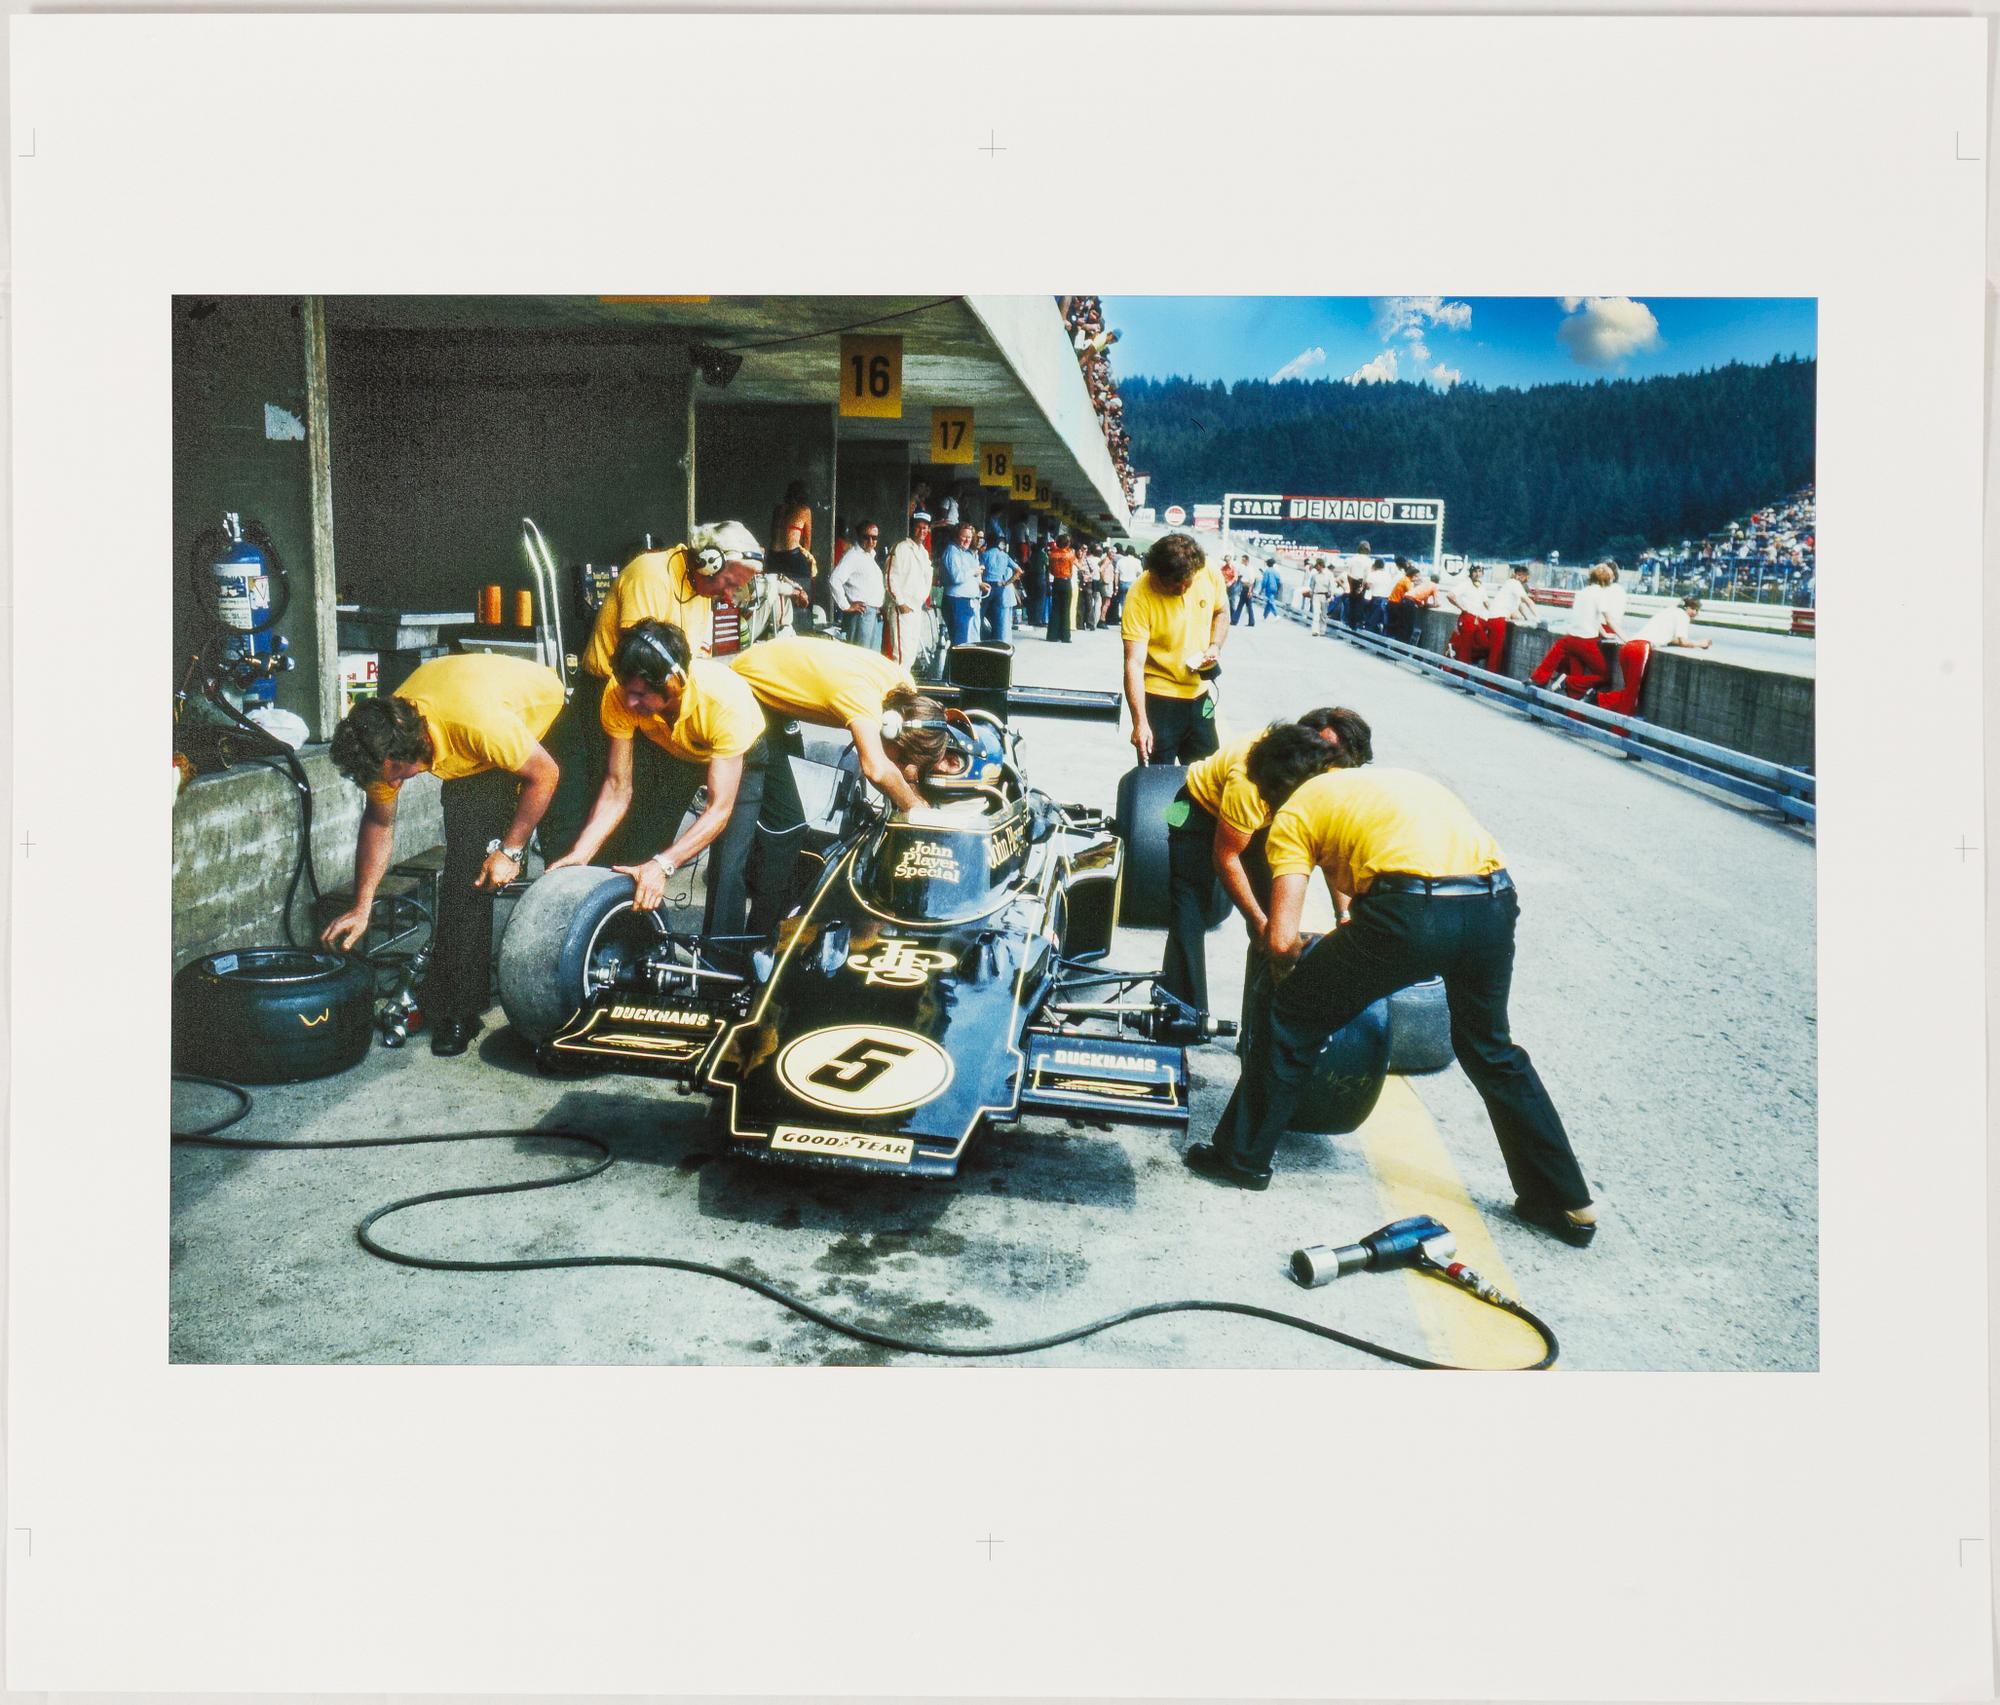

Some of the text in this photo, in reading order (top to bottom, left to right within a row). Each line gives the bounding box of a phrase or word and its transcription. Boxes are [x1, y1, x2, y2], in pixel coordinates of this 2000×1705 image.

[852, 355, 890, 398] 16
[940, 421, 966, 450] 17
[986, 453, 1006, 476] 18
[1014, 474, 1032, 492] 19
[1233, 499, 1434, 519] START TEXACO ZIEL
[902, 851, 959, 869] Player
[910, 841, 953, 858] John
[894, 864, 960, 884] Special
[610, 1005, 710, 1027] DUCKHAMS
[806, 1037, 918, 1093] 5
[1054, 1050, 1157, 1073] DUCKHAMS
